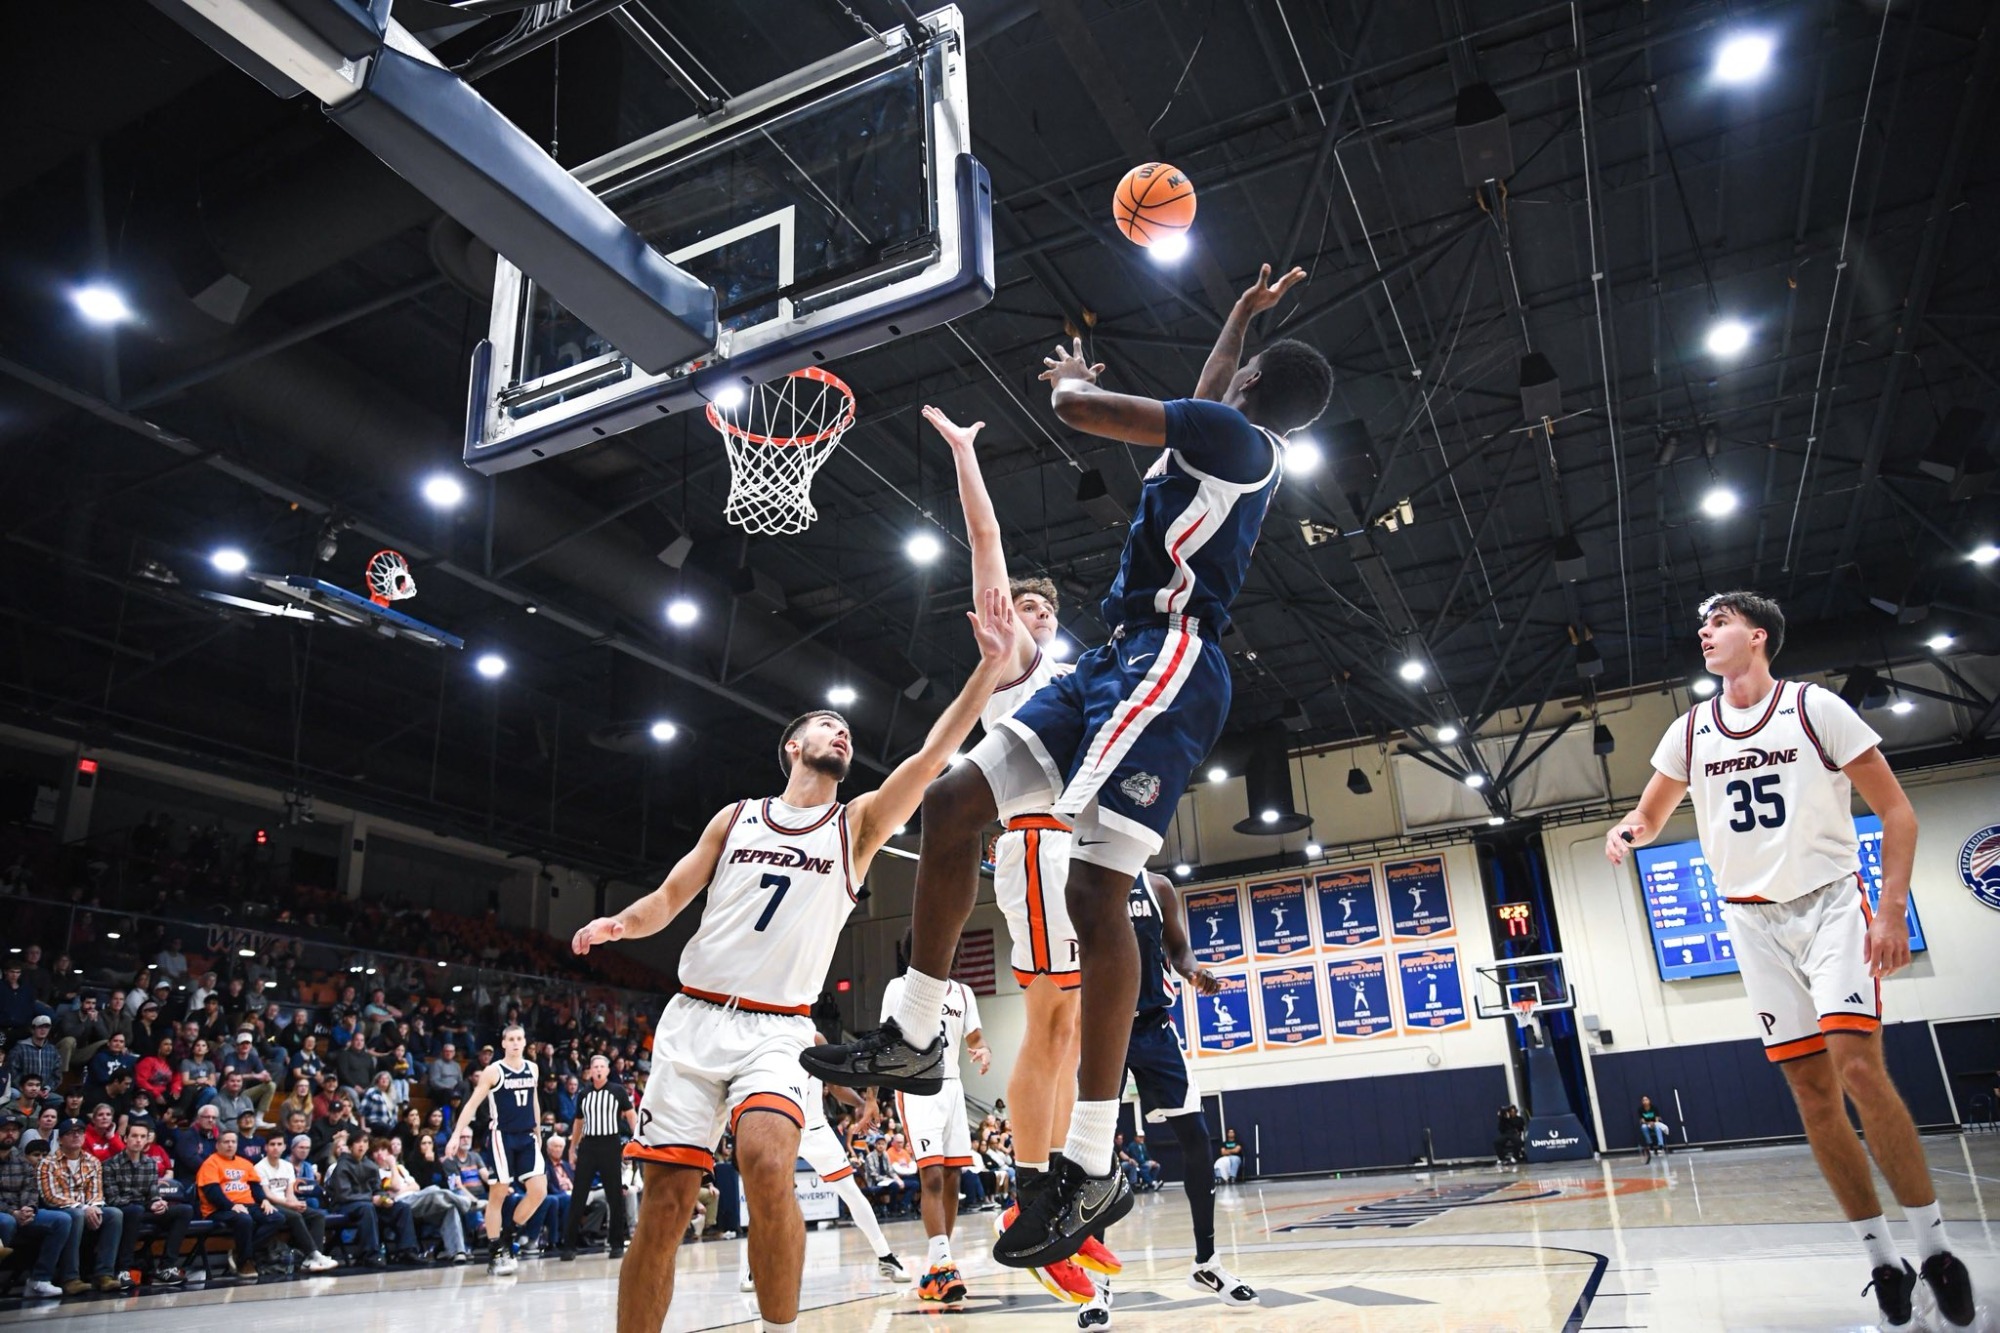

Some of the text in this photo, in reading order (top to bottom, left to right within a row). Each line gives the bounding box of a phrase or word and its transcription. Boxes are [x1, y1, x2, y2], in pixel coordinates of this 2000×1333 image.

[1705, 748, 1798, 777] PEPPERDINE
[1726, 773, 1786, 833] 35
[1961, 828, 1994, 875] PEPPERDINE
[729, 845, 835, 875] PEPPERDINE
[1388, 863, 1440, 879] PEPPERDINE
[1319, 873, 1370, 889] PEPPERDINE
[1252, 884, 1302, 899] PEPPERDINE
[754, 873, 791, 932] 7
[1189, 893, 1235, 908] PEPPERDINE
[1396, 916, 1448, 928] NATIONAL CHAMPIONS
[1509, 917, 1527, 936] 17
[1326, 925, 1377, 938] NATIONAL CHAMPIONS
[1258, 935, 1308, 947] NATIONAL CHAMPIONS
[1194, 944, 1241, 955] NATIONAL CHAMPIONS
[1682, 949, 1693, 964] 3
[1401, 951, 1454, 968] PEPPERDINE
[1330, 961, 1383, 977] PEPPERDINE
[1263, 970, 1313, 985] PEPPERDINE
[1409, 1007, 1462, 1020] NATIONAL CHAMPIONS
[1268, 1023, 1319, 1035] NATIONAL CHAMPIONS
[1337, 1016, 1389, 1028] NATIONAL CHAMPIONS
[1202, 1031, 1251, 1042] NATIONAL CHAMPIONS
[504, 1077, 536, 1089] GONZAGA
[514, 1089, 529, 1107] 17
[1531, 1137, 1579, 1148] UNIVERSITY
[797, 1191, 835, 1201] NIVERSITY
